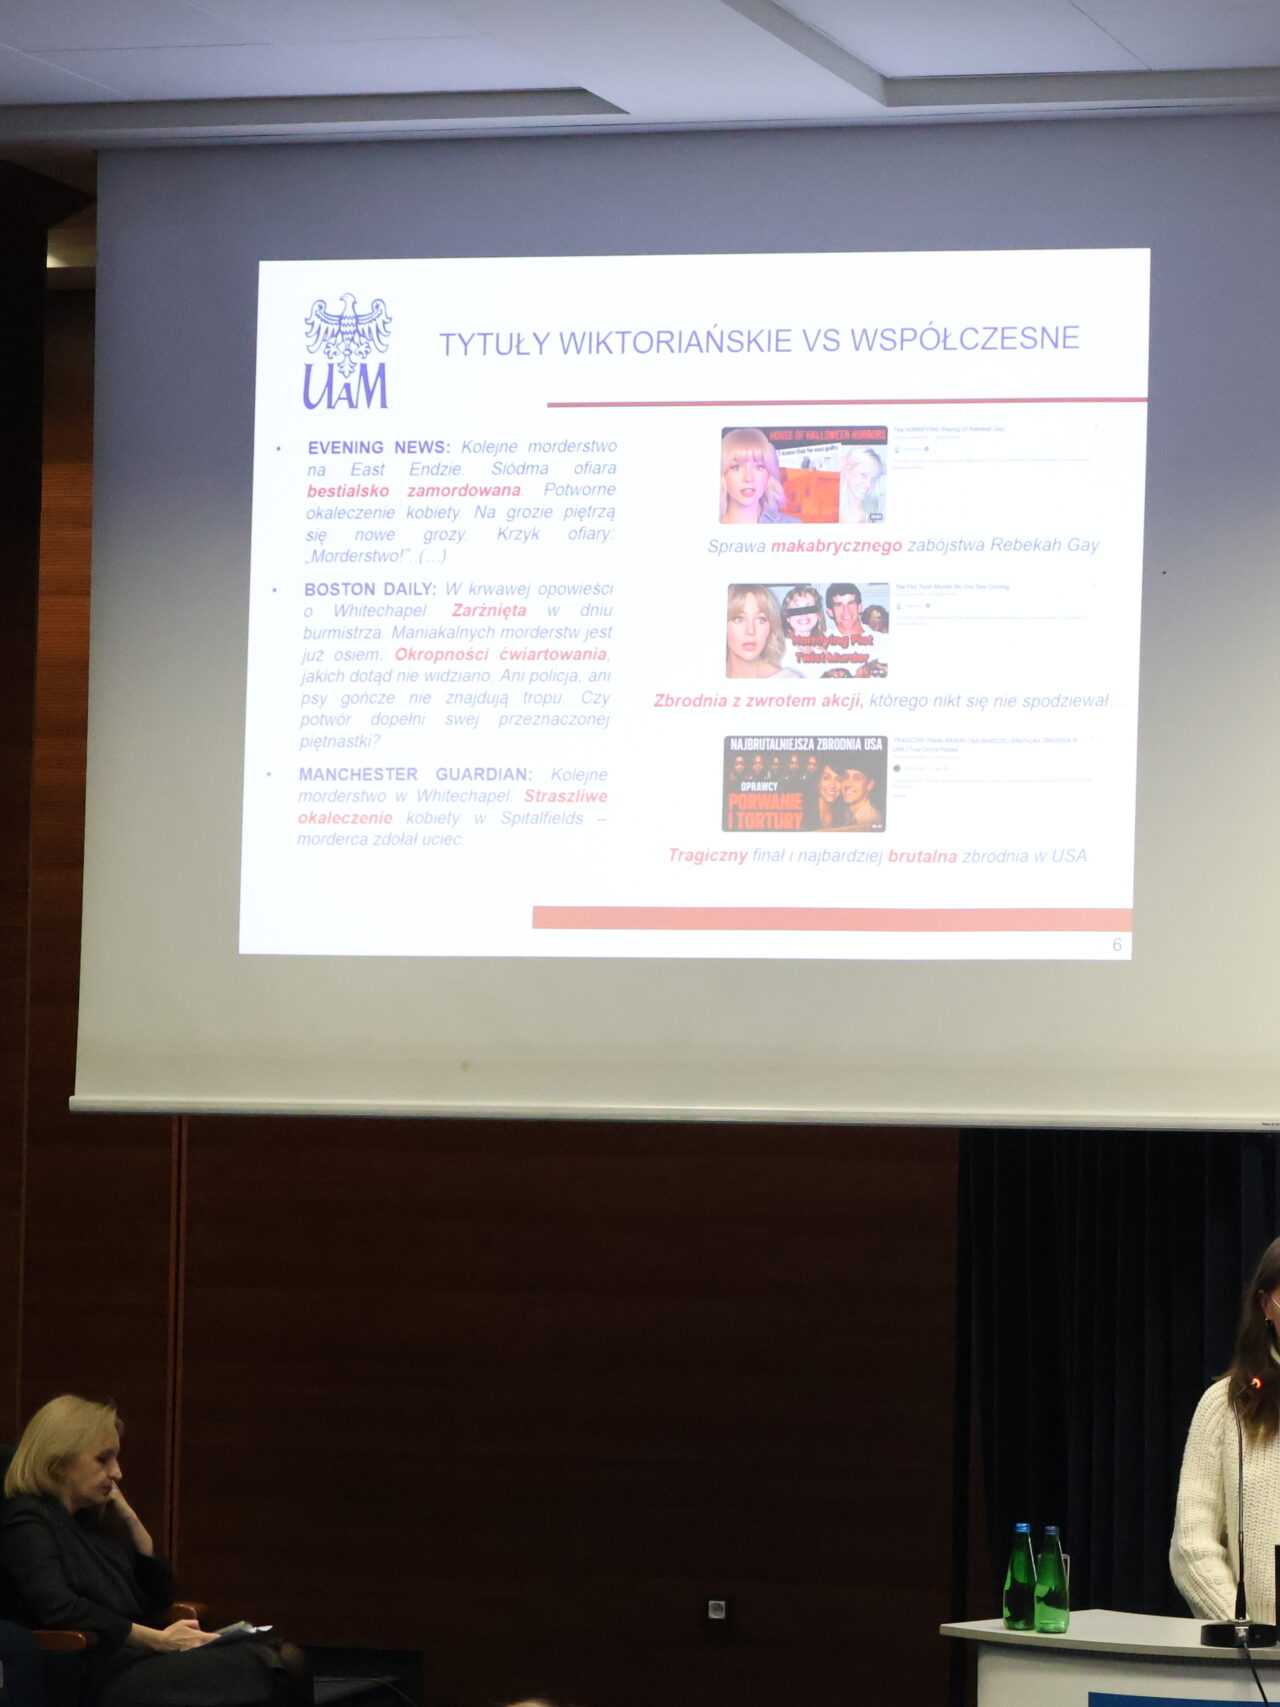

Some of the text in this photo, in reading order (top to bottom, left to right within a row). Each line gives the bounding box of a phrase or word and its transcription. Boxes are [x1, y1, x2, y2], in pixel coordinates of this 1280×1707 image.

[438, 321, 1080, 356] TYTUŁY WIKTORIAŃSKIE VS WSPÓŁCZESNE
[306, 439, 618, 457] EVENING NEWS: Kolejne morderstwo
[307, 466, 328, 476] na
[350, 462, 386, 476] East
[491, 461, 549, 475] Siódma
[574, 461, 616, 474] ofiara
[306, 484, 390, 498] bestialsko
[544, 482, 616, 496] Potworne
[306, 506, 396, 520] okaleczenie
[474, 504, 496, 519] Na
[506, 505, 554, 522] grozie
[563, 504, 616, 522] piętrzą
[305, 528, 327, 545] się
[355, 530, 396, 541] nowe
[497, 527, 540, 544] Krzyk
[708, 537, 1100, 556] Sprawa makabrycznego zabójstwa Rebekah Gay
[304, 582, 614, 599] BOSTON DAILY: W krwawej opowieści
[304, 607, 313, 618] o
[451, 602, 528, 620] Zarżnięta
[548, 606, 560, 616] w
[580, 603, 613, 616] dniu
[392, 625, 495, 642] Maniakalnych
[500, 626, 581, 639] morderstw
[583, 626, 613, 642] jest
[300, 648, 324, 665] już
[394, 647, 490, 664] Okropności
[499, 646, 610, 662] ćwiartowania,
[300, 670, 345, 686] jakich
[350, 669, 393, 686] dotąd
[396, 672, 419, 682] nie
[499, 668, 525, 682] Ani
[528, 669, 581, 686] policja,
[588, 672, 611, 682] ani
[300, 694, 328, 708] psy
[341, 691, 395, 708] gończe
[409, 694, 432, 704] nie
[445, 691, 509, 708] znajdują
[582, 690, 611, 708] Czy
[652, 693, 728, 708] Zbrodnia
[732, 696, 742, 707] z
[745, 694, 816, 707] zwrotem
[821, 693, 864, 711] akcji,
[869, 694, 928, 711] którego
[933, 694, 962, 707] nikt
[966, 697, 988, 711] się
[994, 695, 1017, 708] nie
[300, 712, 611, 729] potwór dopełni swej przeznaczonej
[299, 734, 381, 751] piętnastki?
[730, 738, 882, 750] NAJBRUTALNIEJSZA ZBRODNIA USA
[299, 767, 608, 785] MANCHESTER GUARDIAN: Kolejne
[741, 782, 778, 791] OPRAWCY
[298, 789, 386, 802] morderstwo
[396, 792, 408, 802] w
[524, 789, 608, 802] Straszliwe
[729, 793, 804, 810] PORWANIE
[298, 811, 394, 824] okaleczenie
[406, 811, 461, 827] kobiety
[474, 814, 487, 824] w
[501, 811, 584, 826] Spitalfields
[728, 812, 804, 829] I TORTURY
[297, 832, 368, 846] morderca
[372, 832, 418, 846] zdołał
[669, 848, 748, 865] Tragiczny
[753, 848, 785, 862] finał
[798, 849, 883, 866] najbardziej
[888, 849, 958, 863] brutalna
[962, 850, 1029, 863] zbrodnia
[1034, 852, 1047, 862] w
[1052, 849, 1087, 862] USA
[1113, 938, 1122, 951] 6
